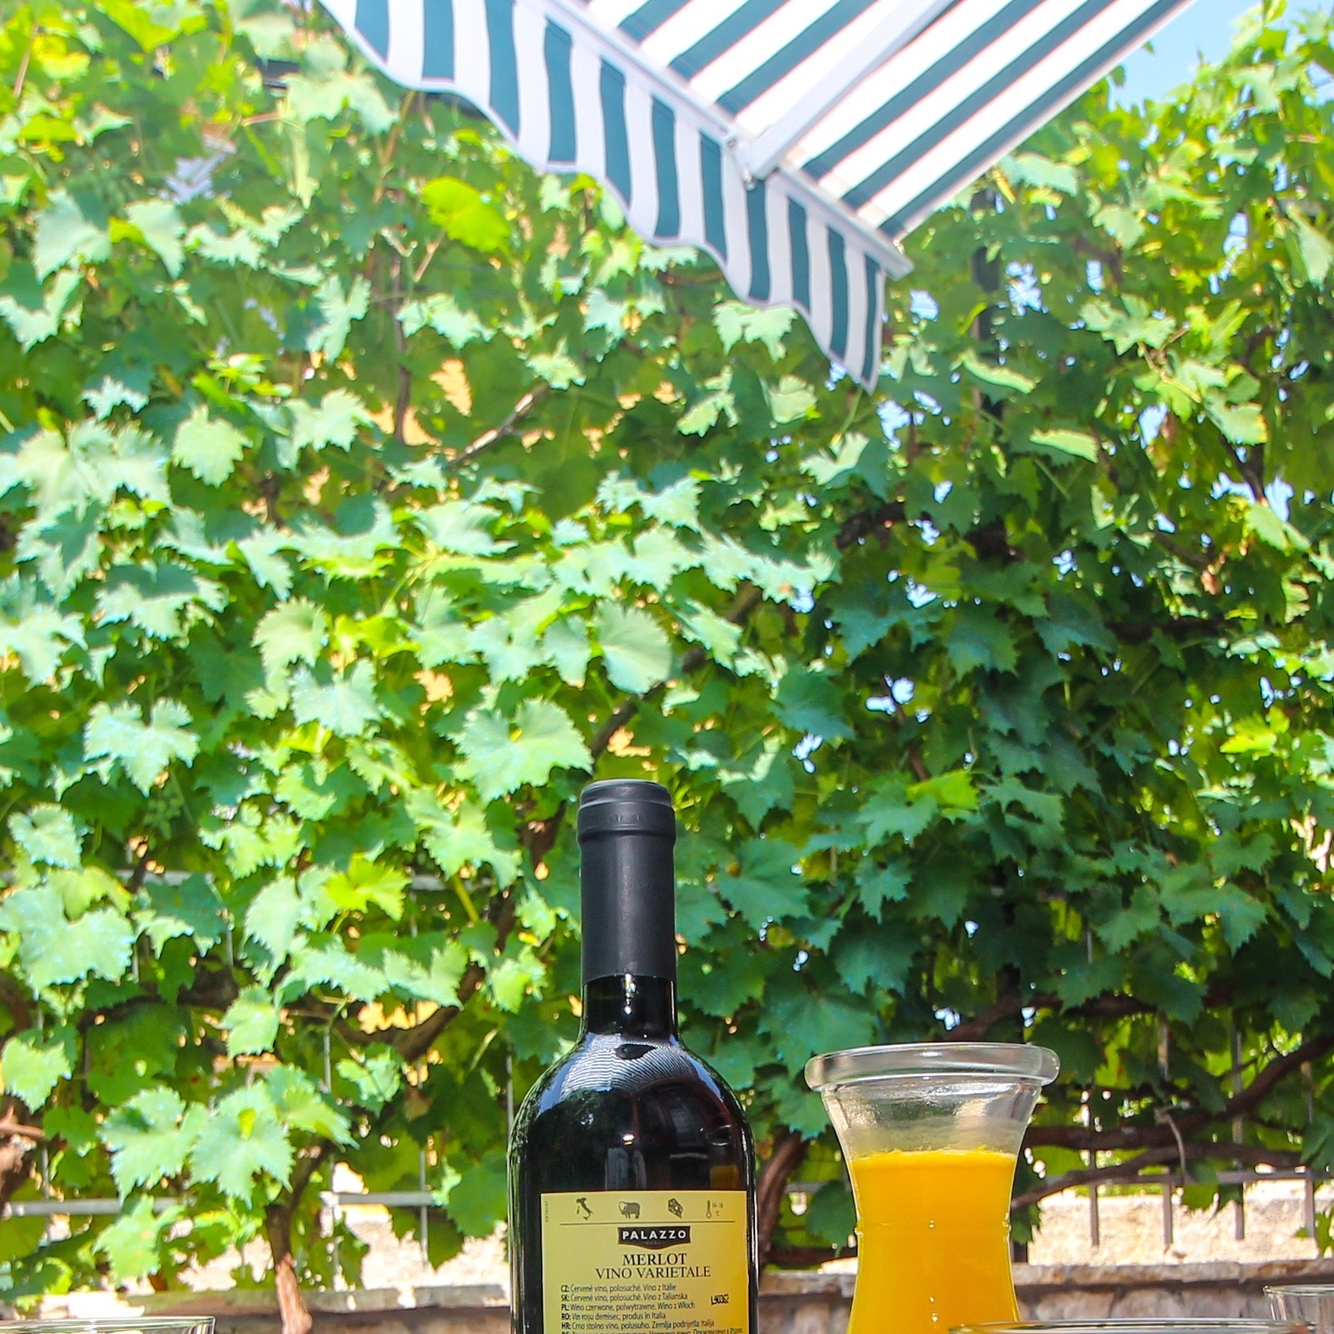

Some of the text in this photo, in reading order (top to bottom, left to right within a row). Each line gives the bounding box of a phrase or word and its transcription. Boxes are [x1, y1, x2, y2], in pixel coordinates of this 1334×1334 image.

[622, 1230, 686, 1240] PALAZZO
[622, 1253, 687, 1266] MERLOT
[595, 1266, 711, 1279] VINO VARIETALE
[622, 1312, 644, 1321] produs
